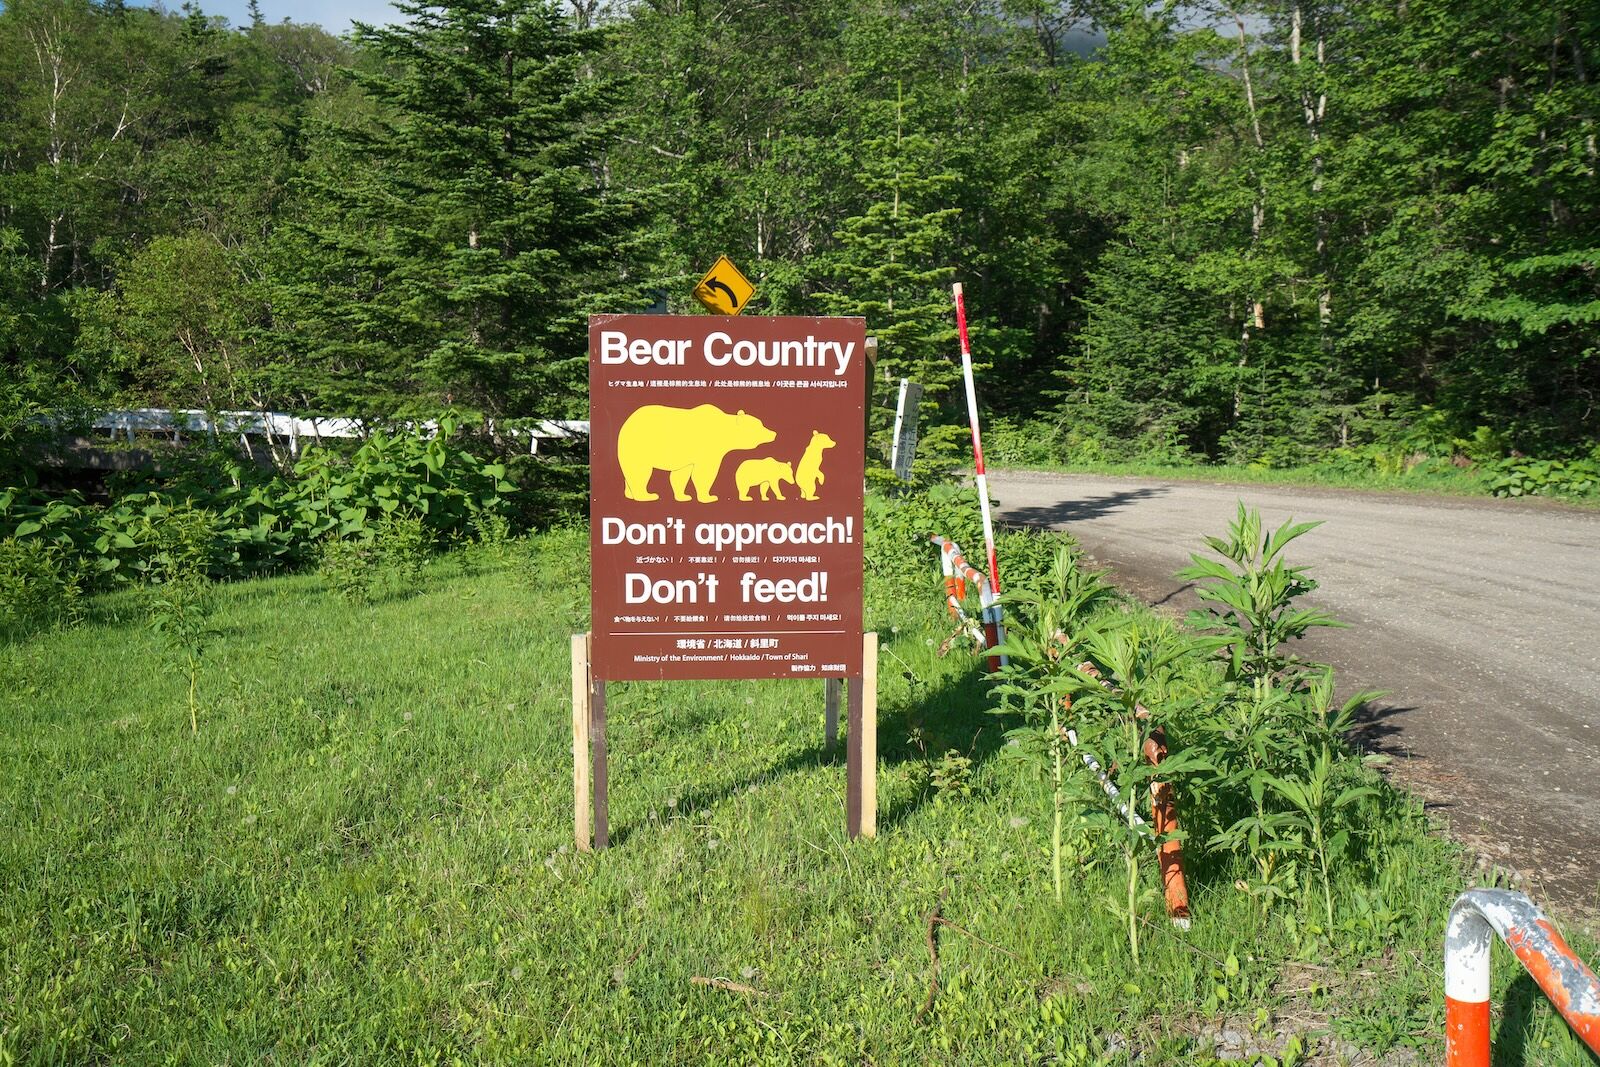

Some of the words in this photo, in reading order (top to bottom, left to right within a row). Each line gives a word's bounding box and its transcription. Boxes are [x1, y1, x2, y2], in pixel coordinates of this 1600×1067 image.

[600, 330, 693, 366] Bear
[703, 331, 856, 376] Country
[601, 517, 686, 546] Don't
[694, 515, 854, 552] approach!
[625, 572, 720, 604] Don't
[739, 571, 828, 604] feed!
[633, 654, 661, 664] Ministry
[660, 654, 668, 662] of
[669, 654, 682, 662] the
[682, 653, 724, 662] Environment
[729, 653, 761, 661] Hokkaido
[765, 653, 783, 661] Town
[783, 652, 792, 661] of
[791, 652, 809, 661] Shari
[676, 638, 706, 650] 環境省
[712, 638, 743, 650] 北海道
[749, 637, 780, 650] 斜里町
